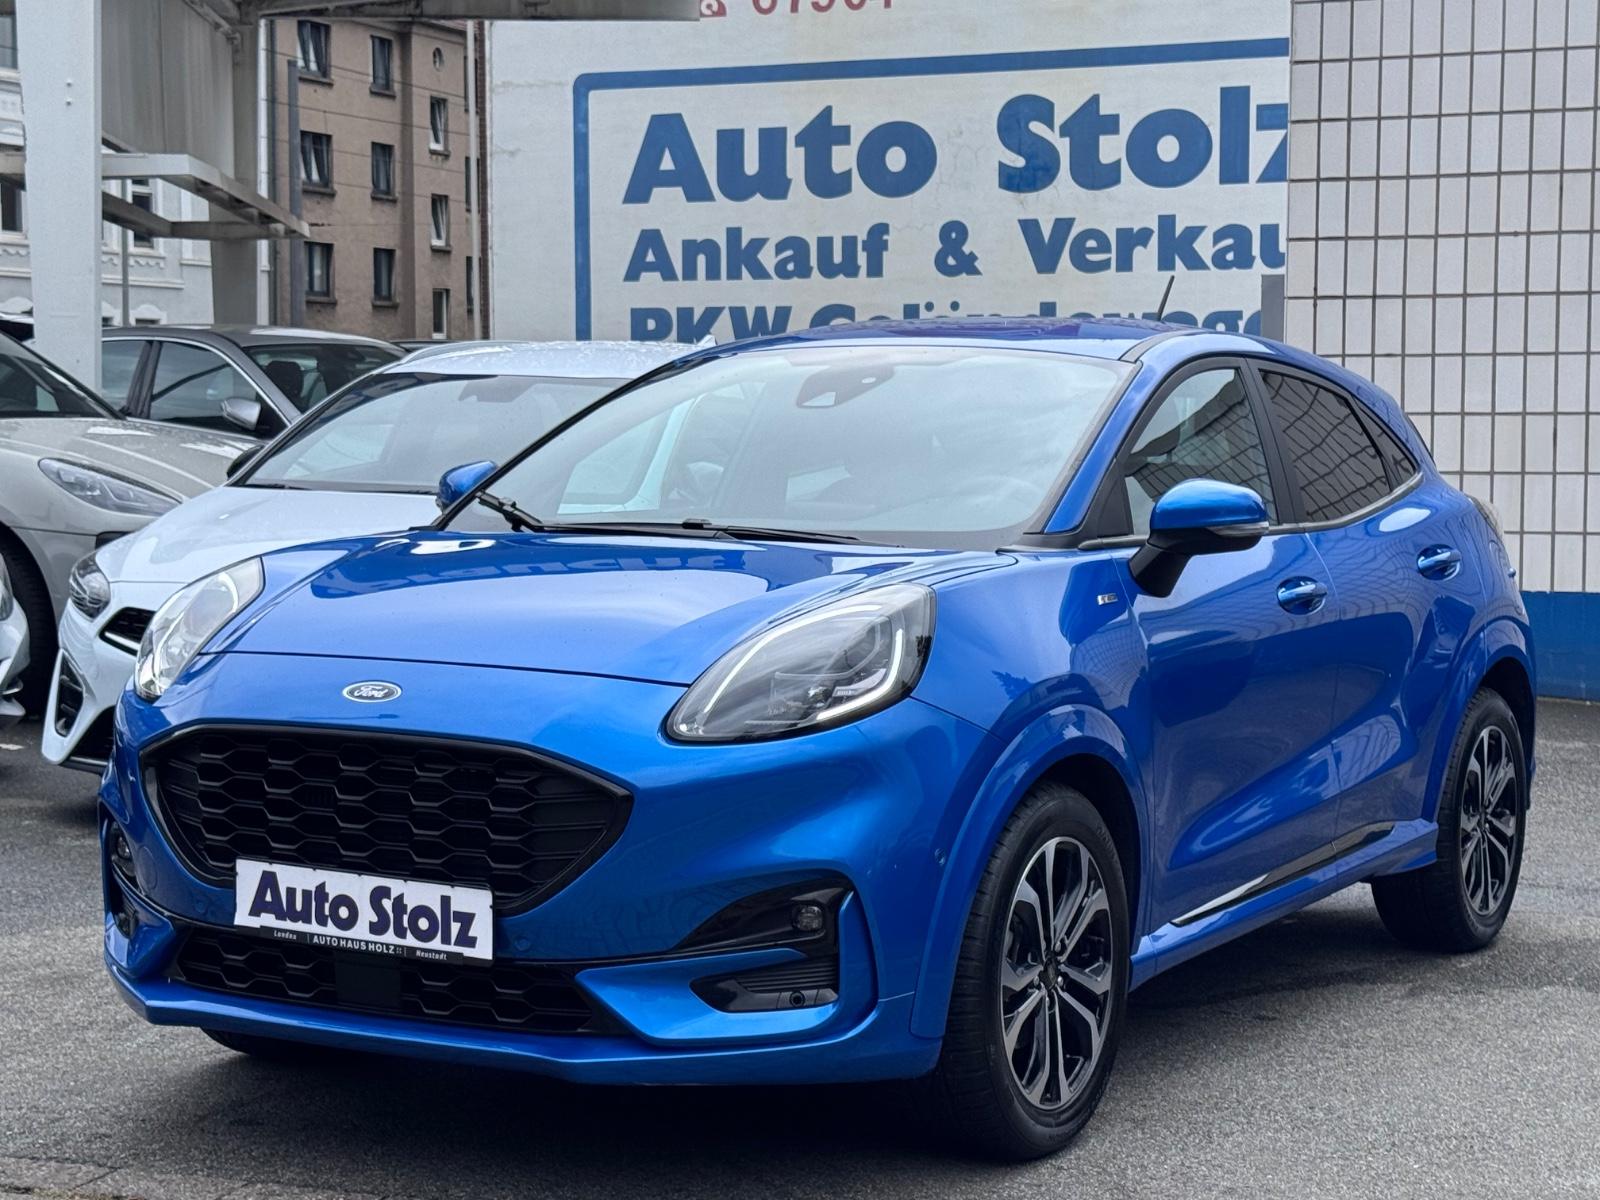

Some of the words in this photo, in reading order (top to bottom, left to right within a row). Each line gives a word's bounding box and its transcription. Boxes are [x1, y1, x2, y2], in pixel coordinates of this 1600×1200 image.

[622, 105, 938, 205] Auto
[622, 222, 890, 283] Ankauf
[934, 219, 982, 278] &
[630, 305, 792, 342] PKW
[354, 685, 389, 698] Ford
[248, 869, 360, 932] Auto
[368, 885, 479, 949] Stolz
[368, 942, 395, 954] HOLZ
